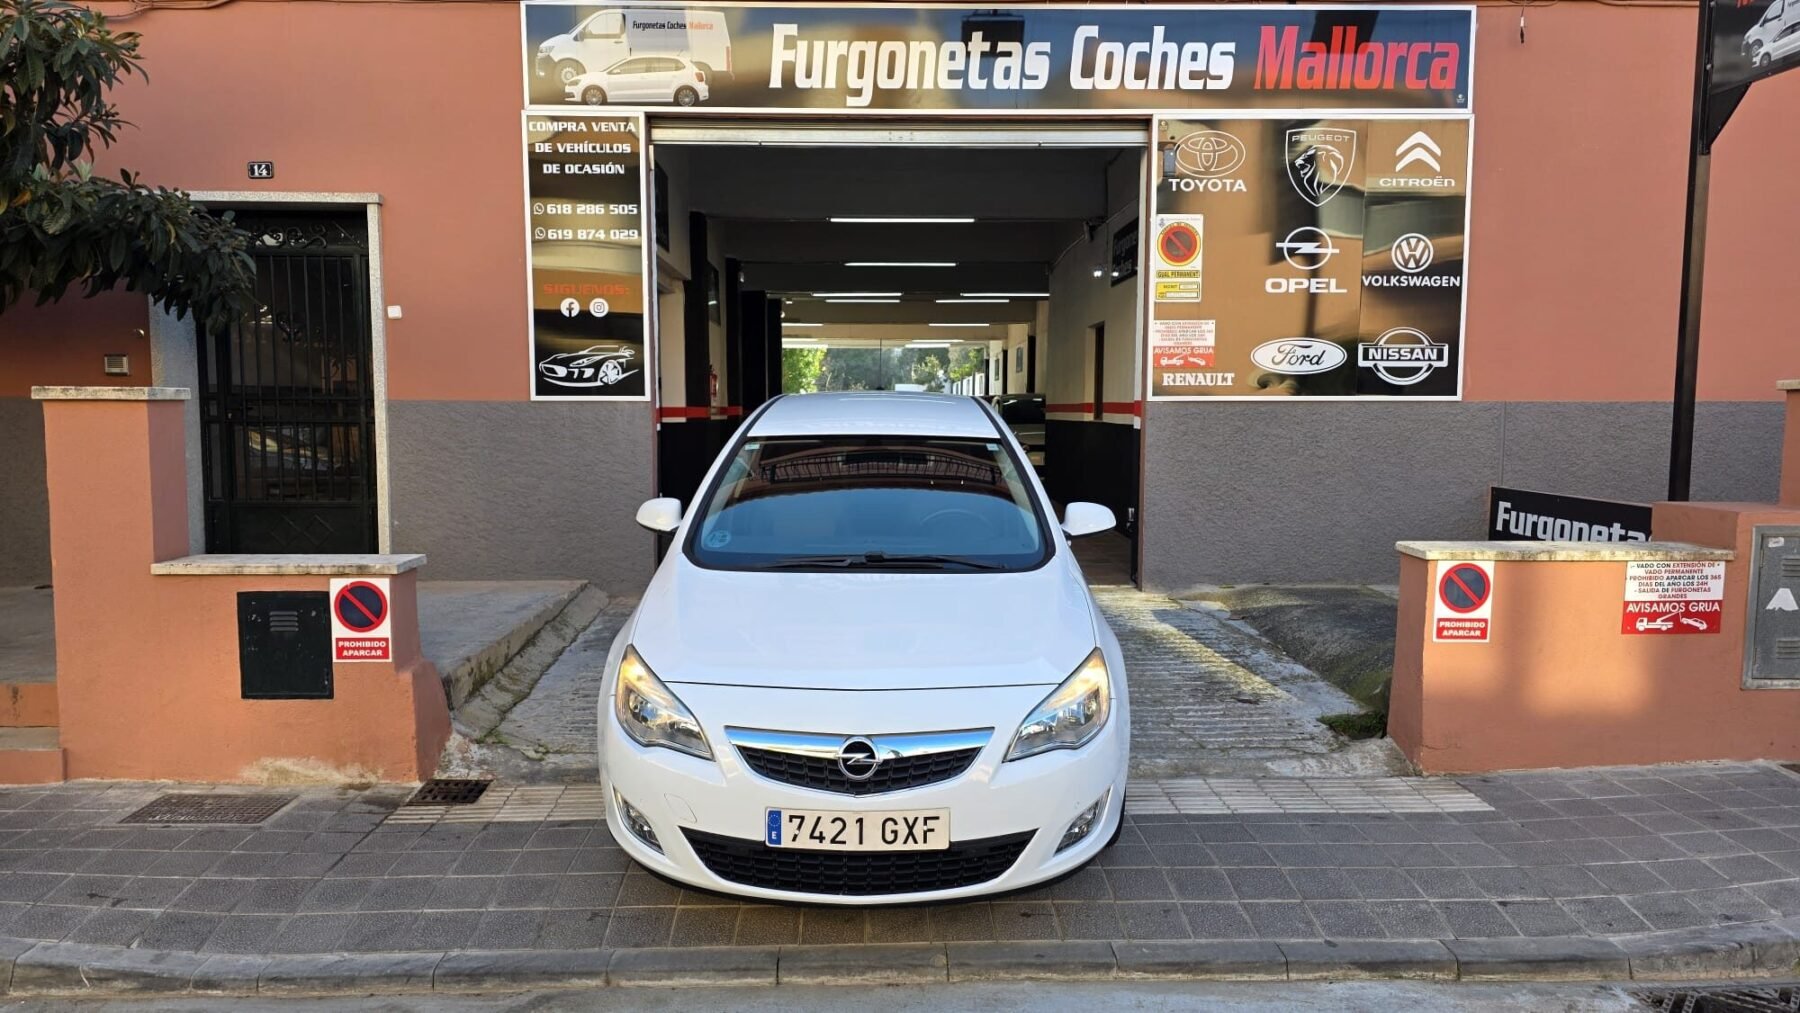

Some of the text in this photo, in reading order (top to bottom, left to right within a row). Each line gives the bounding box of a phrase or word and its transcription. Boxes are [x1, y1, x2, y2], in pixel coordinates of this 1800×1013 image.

[632, 21, 666, 31] Furgonetas
[667, 21, 686, 30] Coches
[769, 23, 1460, 107] Furgonetas Coches Mallorca
[528, 121, 636, 132] COMPRA VENTA
[1291, 133, 1350, 143] PEUGEOT
[535, 140, 631, 153] DE VEHÍCULOS
[253, 164, 268, 176] 14
[543, 161, 625, 174] DE OCASIÓN
[1168, 178, 1247, 193] TOYOTA
[546, 203, 638, 215] 618 286 505
[547, 229, 639, 240] 619 874 029
[1265, 278, 1348, 294] OPEL
[1362, 275, 1460, 287] VOLKSWAGEN
[1271, 343, 1326, 366] Ford
[1368, 349, 1437, 360] NISSAN
[1162, 373, 1235, 386] RENAULT
[1496, 501, 1653, 542] Furgoneta
[1626, 602, 1721, 613] AVISAMOS GRUA
[771, 831, 777, 839] E
[788, 814, 940, 845] 7421 GXF
